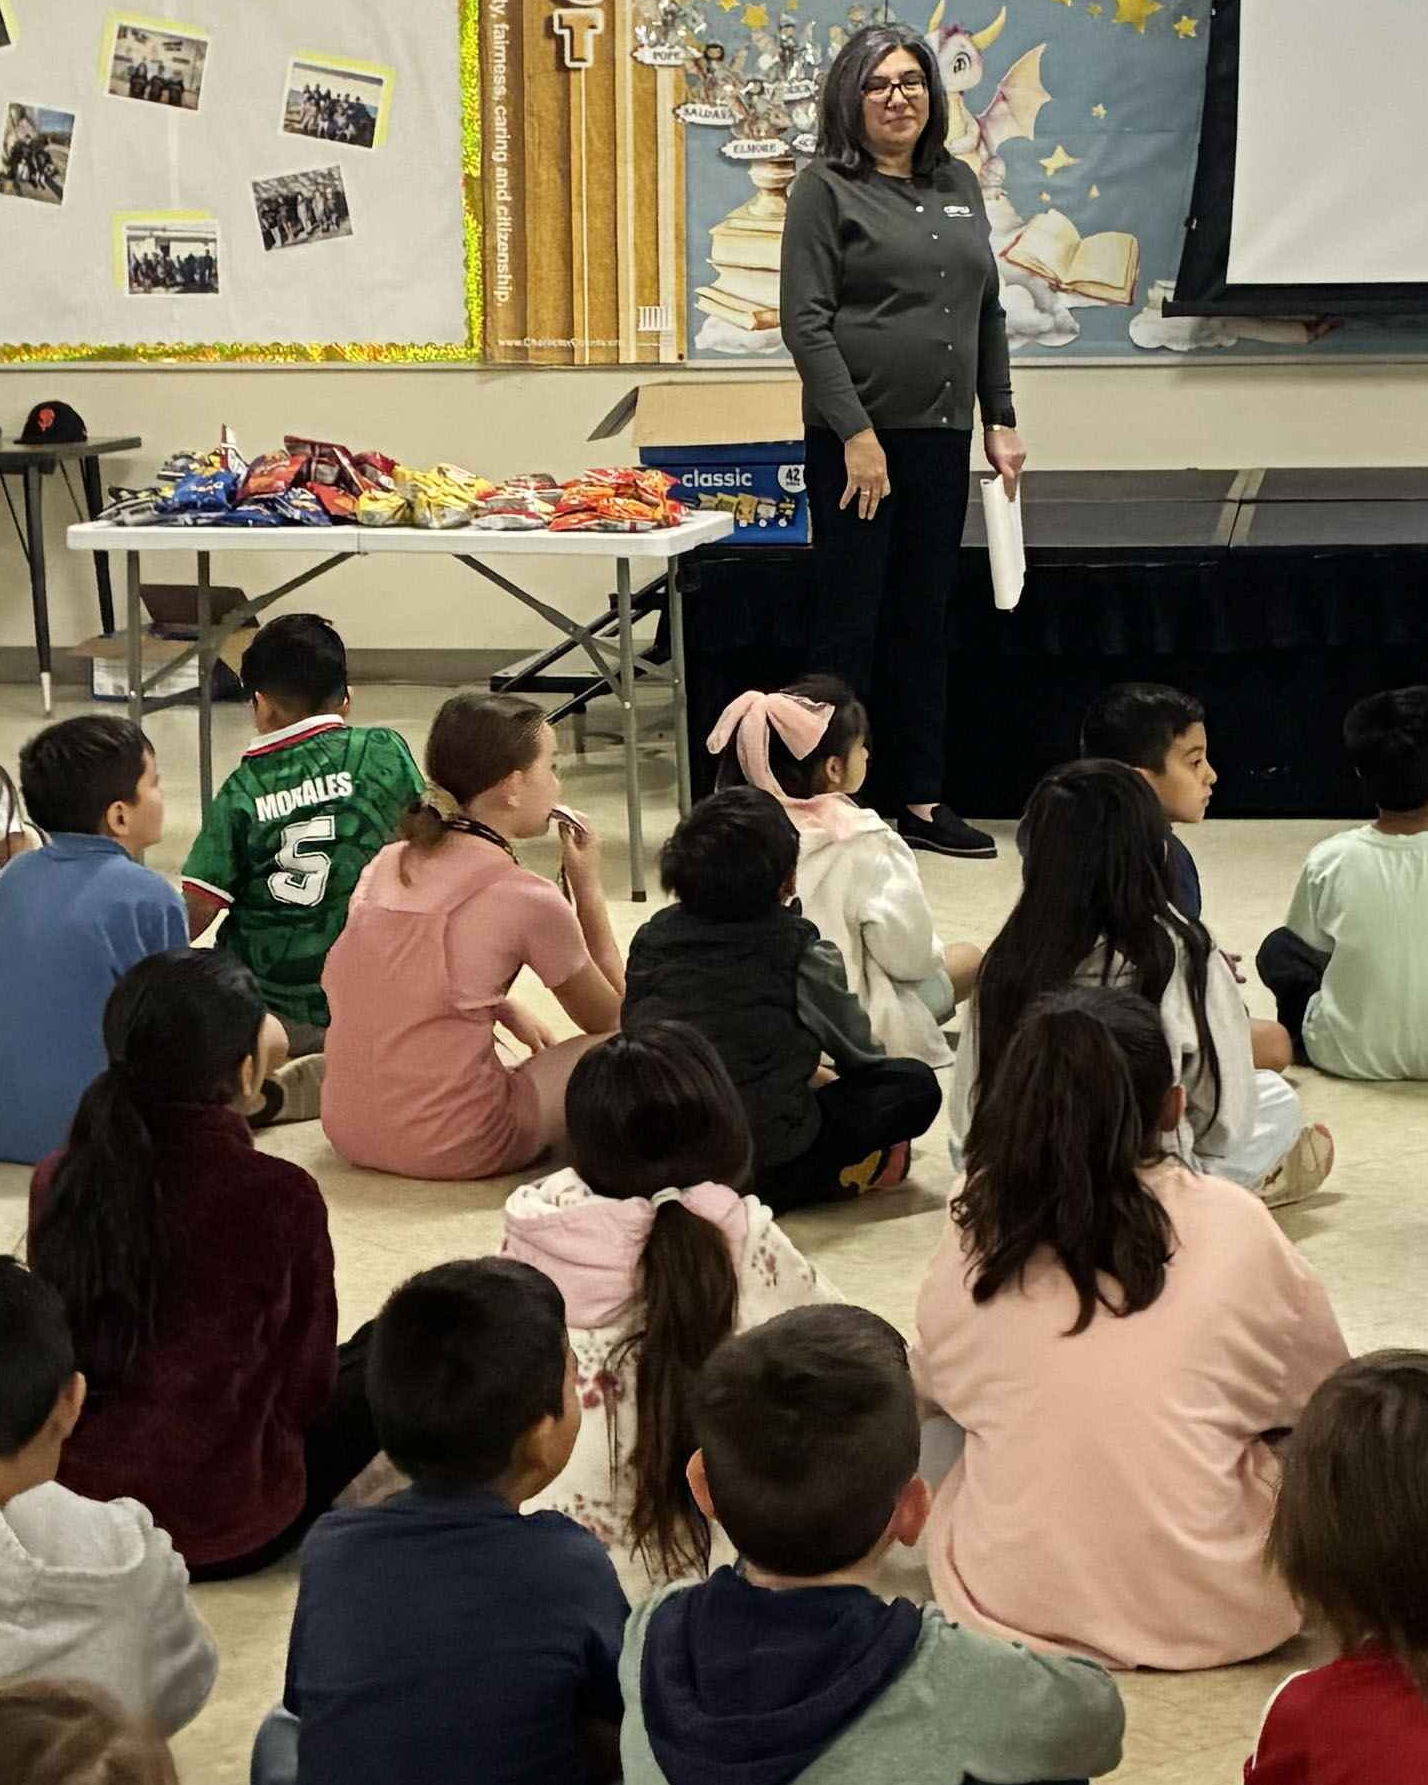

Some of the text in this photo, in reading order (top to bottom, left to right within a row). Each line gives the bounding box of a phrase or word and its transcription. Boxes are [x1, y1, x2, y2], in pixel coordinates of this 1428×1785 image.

[492, 23, 511, 100] fairness,
[492, 105, 511, 163] caring
[495, 166, 512, 202] and
[493, 205, 513, 307] citizenship.
[682, 468, 752, 487] classic
[785, 467, 801, 482] 42
[267, 815, 336, 906] 5
